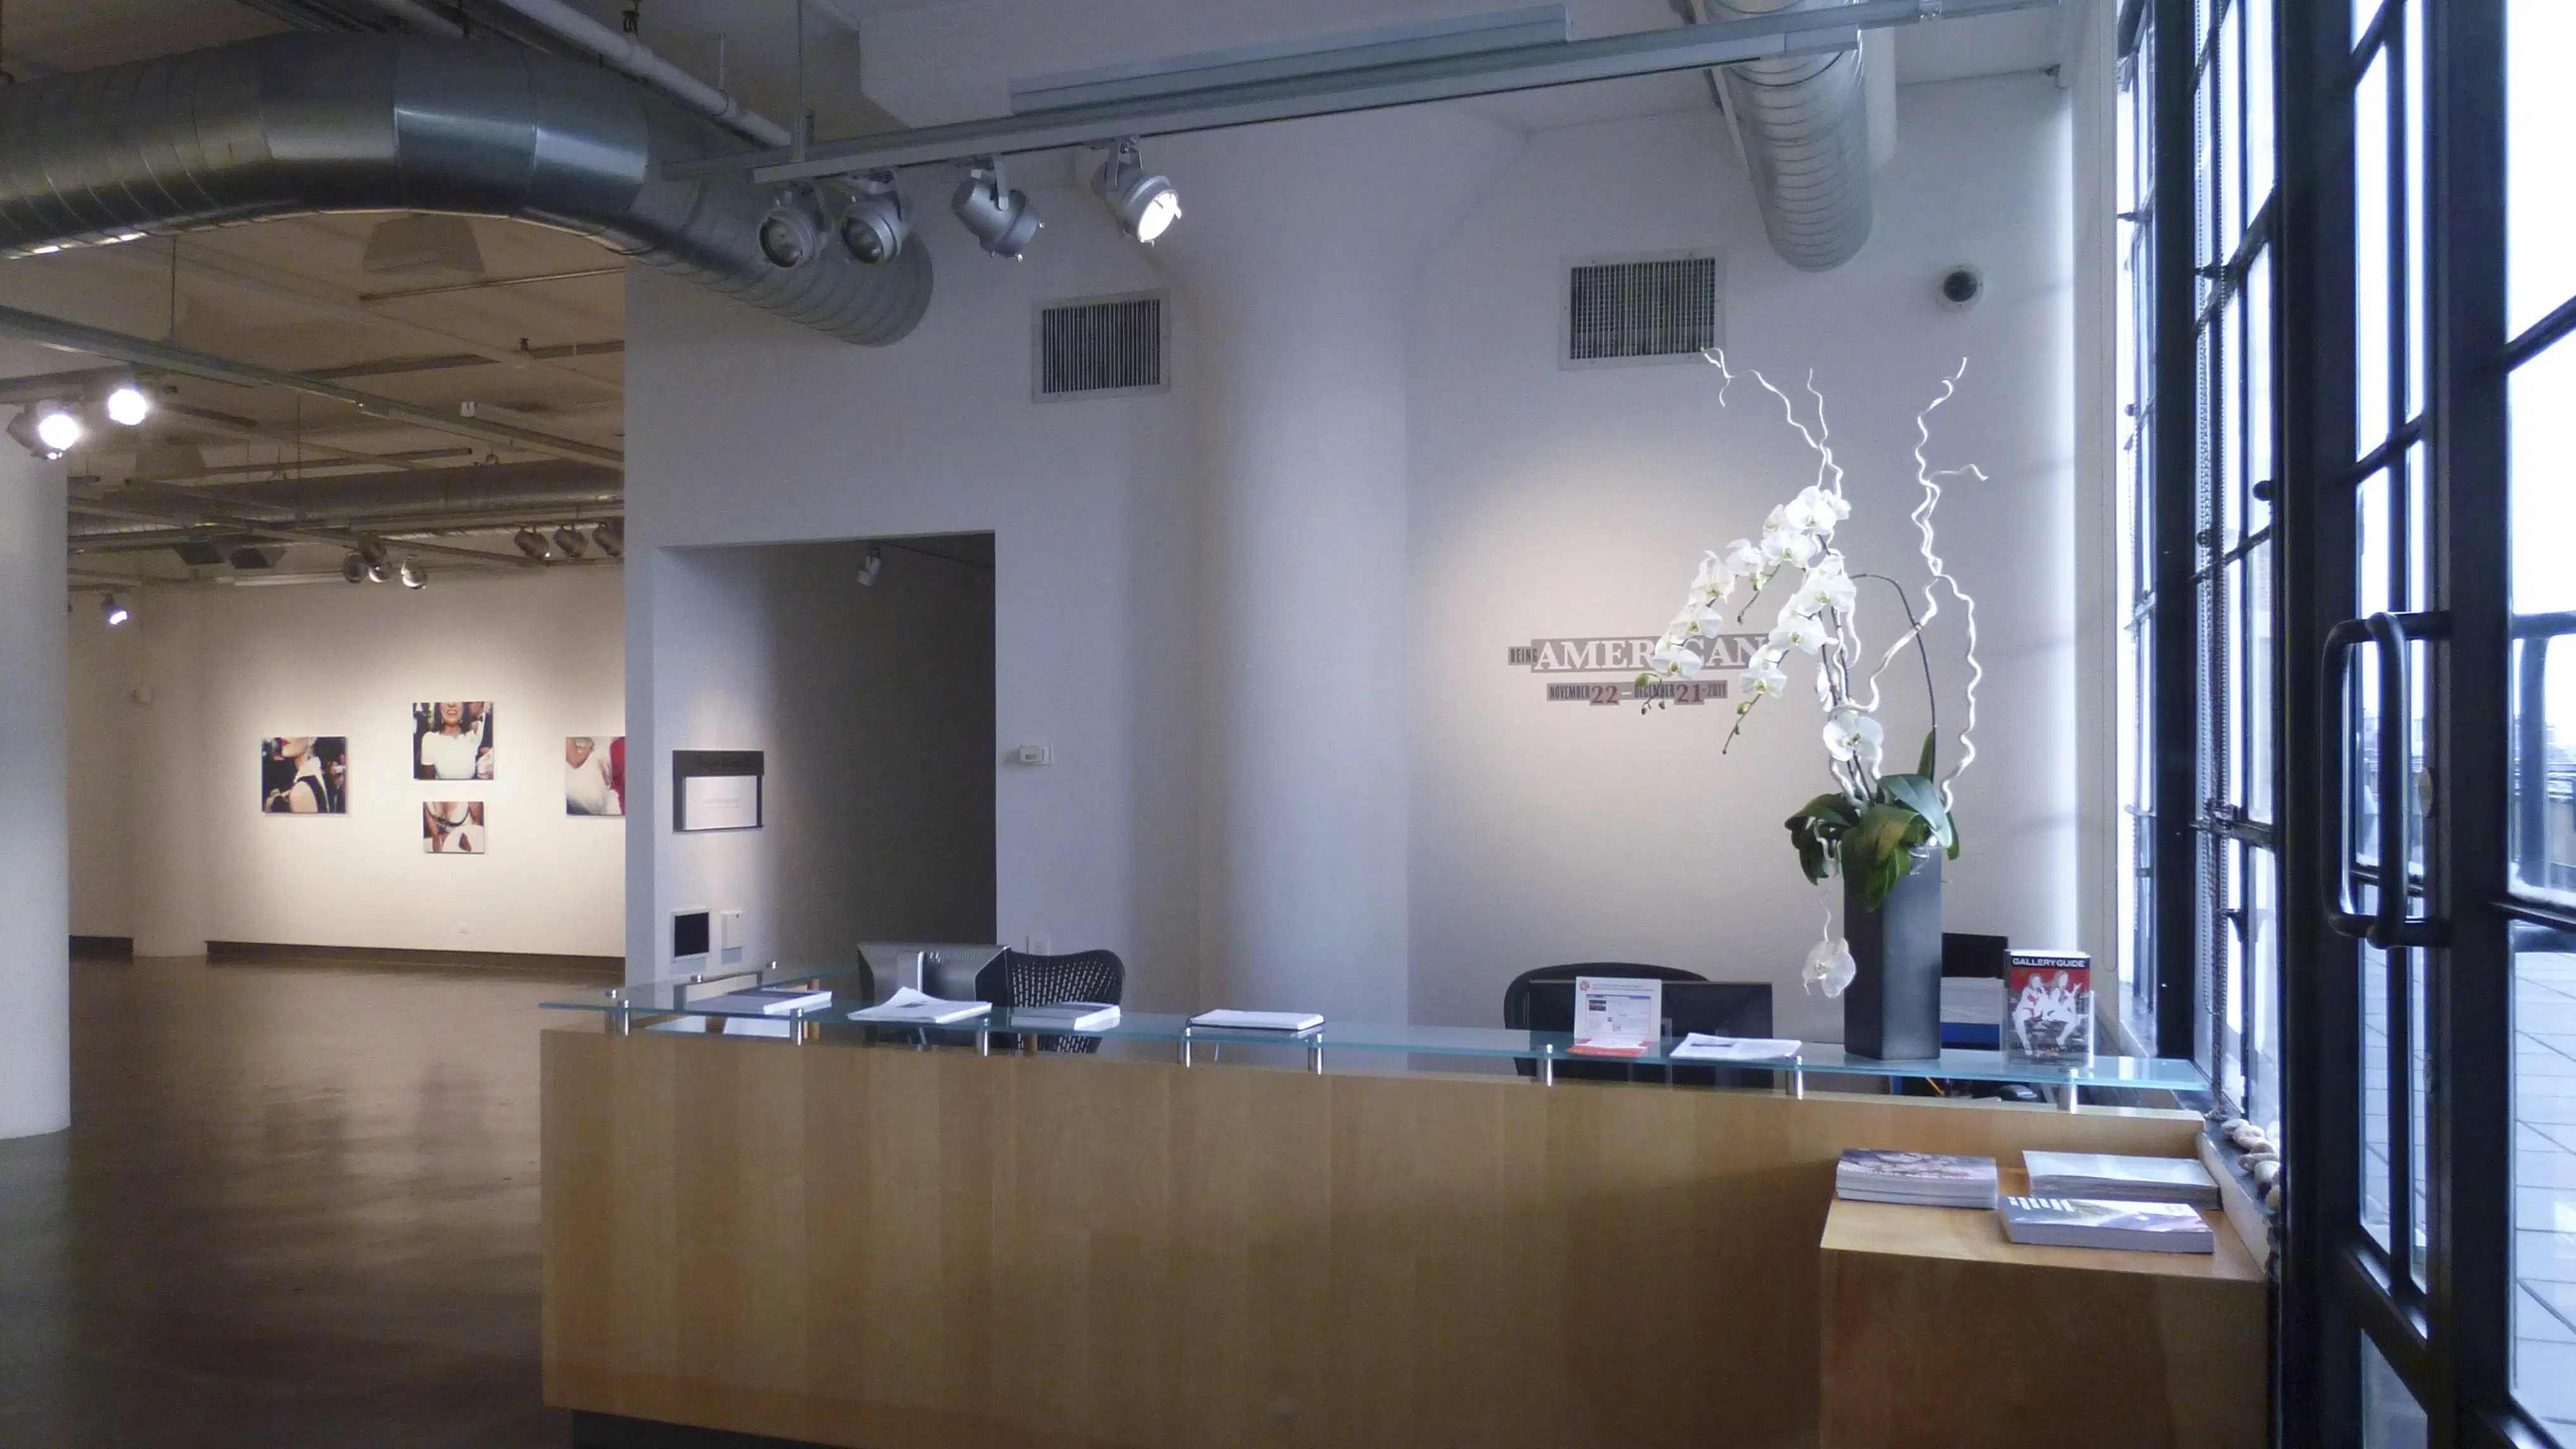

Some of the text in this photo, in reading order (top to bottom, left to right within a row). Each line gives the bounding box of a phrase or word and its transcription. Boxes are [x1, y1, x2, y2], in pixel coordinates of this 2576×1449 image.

[1510, 648, 1538, 662] BEING
[1591, 685, 1618, 704] 22
[1676, 683, 1702, 702] 21
